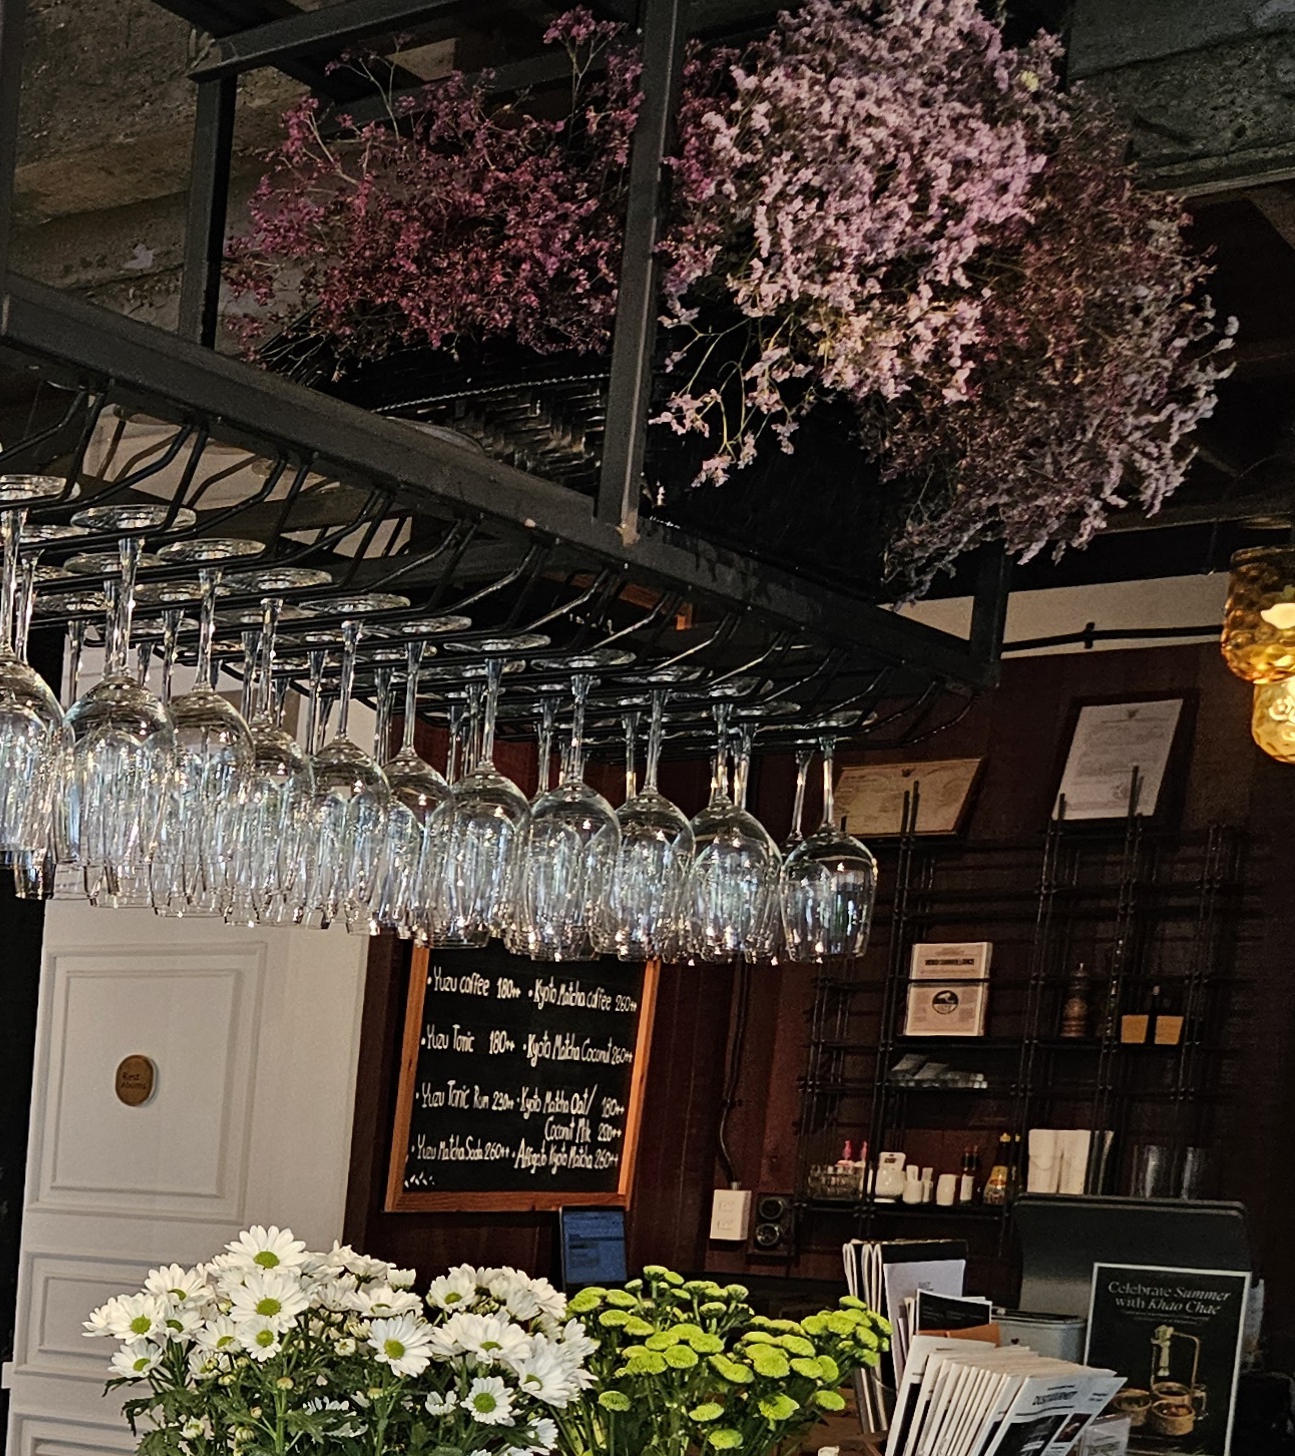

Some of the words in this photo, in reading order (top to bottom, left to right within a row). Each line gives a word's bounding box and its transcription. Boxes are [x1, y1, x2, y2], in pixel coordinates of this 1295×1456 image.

[433, 965, 458, 991] Yuzu
[533, 976, 557, 1010] Kyoto
[556, 981, 586, 1006] Matcha
[426, 1024, 449, 1050] Yuzu
[452, 1024, 475, 1052] Tonic
[526, 1030, 551, 1068] Kyoto
[551, 1033, 580, 1060] Matcha
[581, 1037, 612, 1064] Coconut
[421, 1082, 445, 1108] Yuzu
[447, 1080, 470, 1109] Tonic
[519, 1086, 542, 1120] Kyoto
[542, 1090, 569, 1114] Matcha
[544, 1116, 575, 1142] Coconut
[417, 1134, 437, 1160] Yuzu
[437, 1134, 465, 1160] Matcha
[465, 1135, 483, 1160] Soda
[567, 1144, 593, 1170] Matcha
[1108, 1281, 1172, 1298] Celebrate
[1174, 1286, 1231, 1302] Summer
[1115, 1297, 1145, 1309] with
[1148, 1298, 1183, 1312] Khao
[1185, 1300, 1221, 1315] Chae
